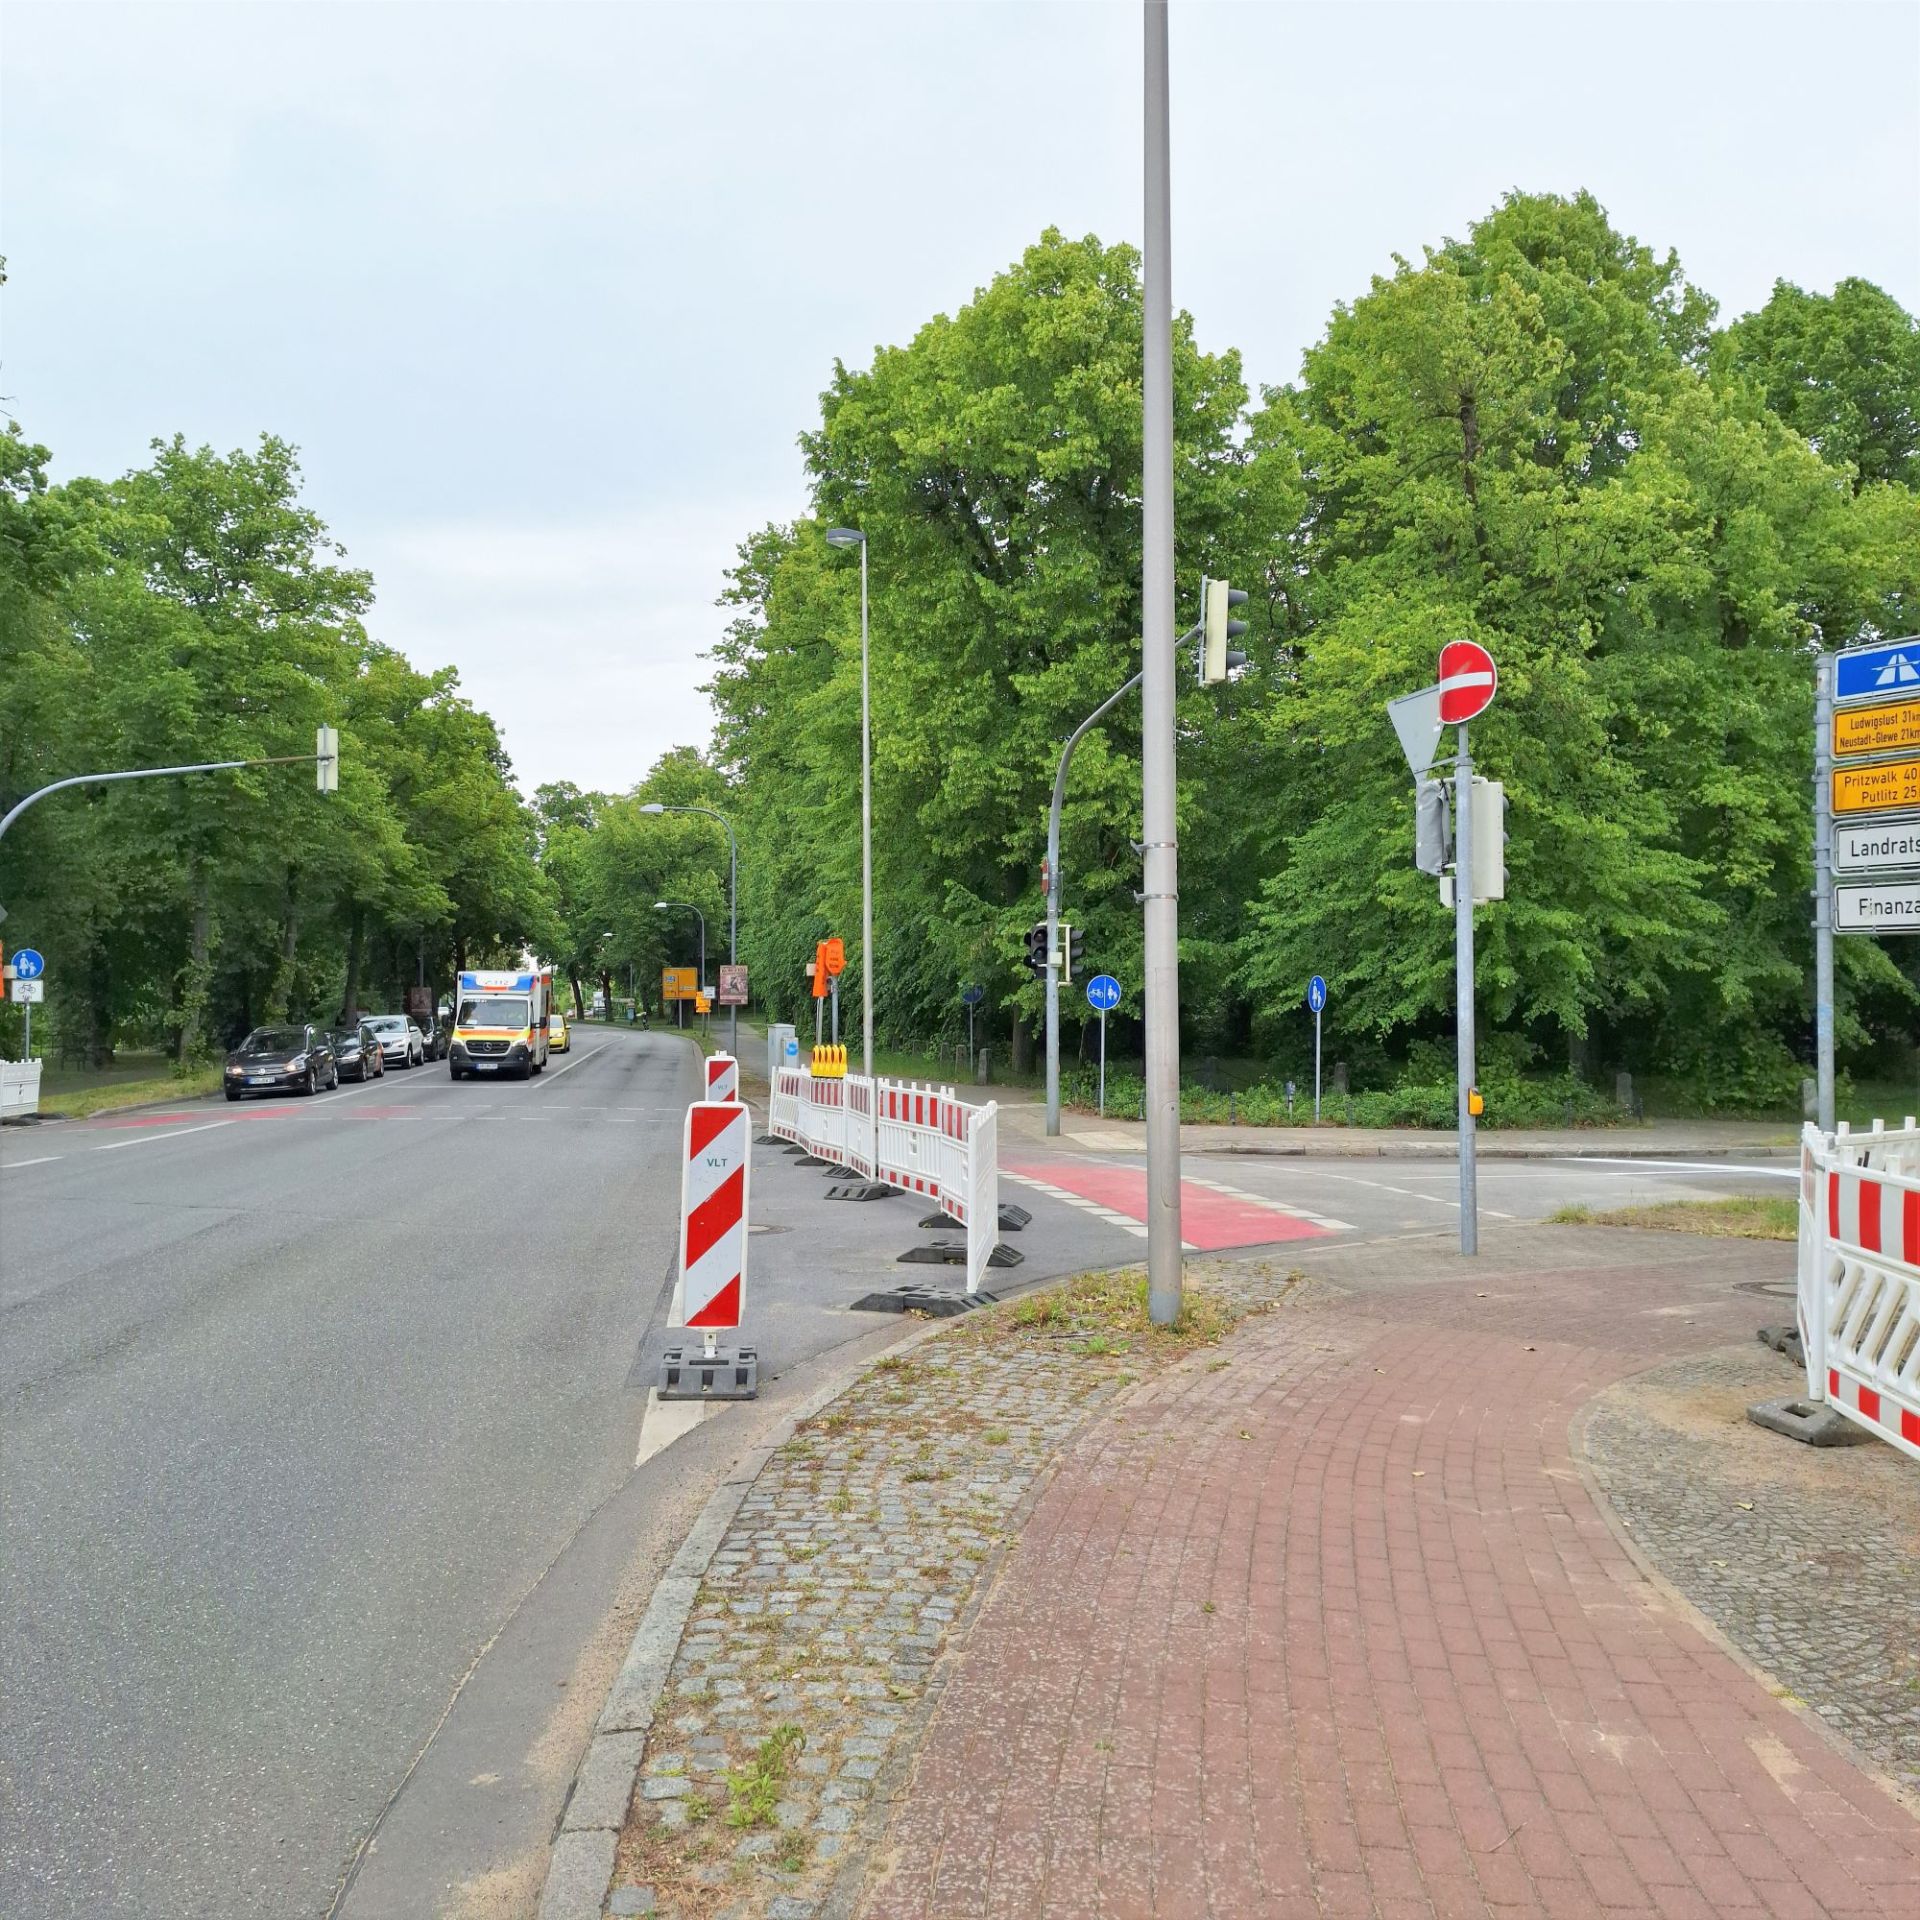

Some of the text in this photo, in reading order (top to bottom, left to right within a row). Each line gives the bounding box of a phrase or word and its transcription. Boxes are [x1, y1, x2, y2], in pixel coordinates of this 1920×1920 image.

[1850, 713, 1898, 730] Ludwigslust
[1840, 731, 1898, 748] Neustadt-Glewe
[1844, 770, 1898, 788] Pritzwalk
[1861, 789, 1898, 803] Putlitz
[1851, 836, 1920, 857] Landrats
[1859, 898, 1920, 916] Finanza
[707, 1158, 727, 1167] VLT
